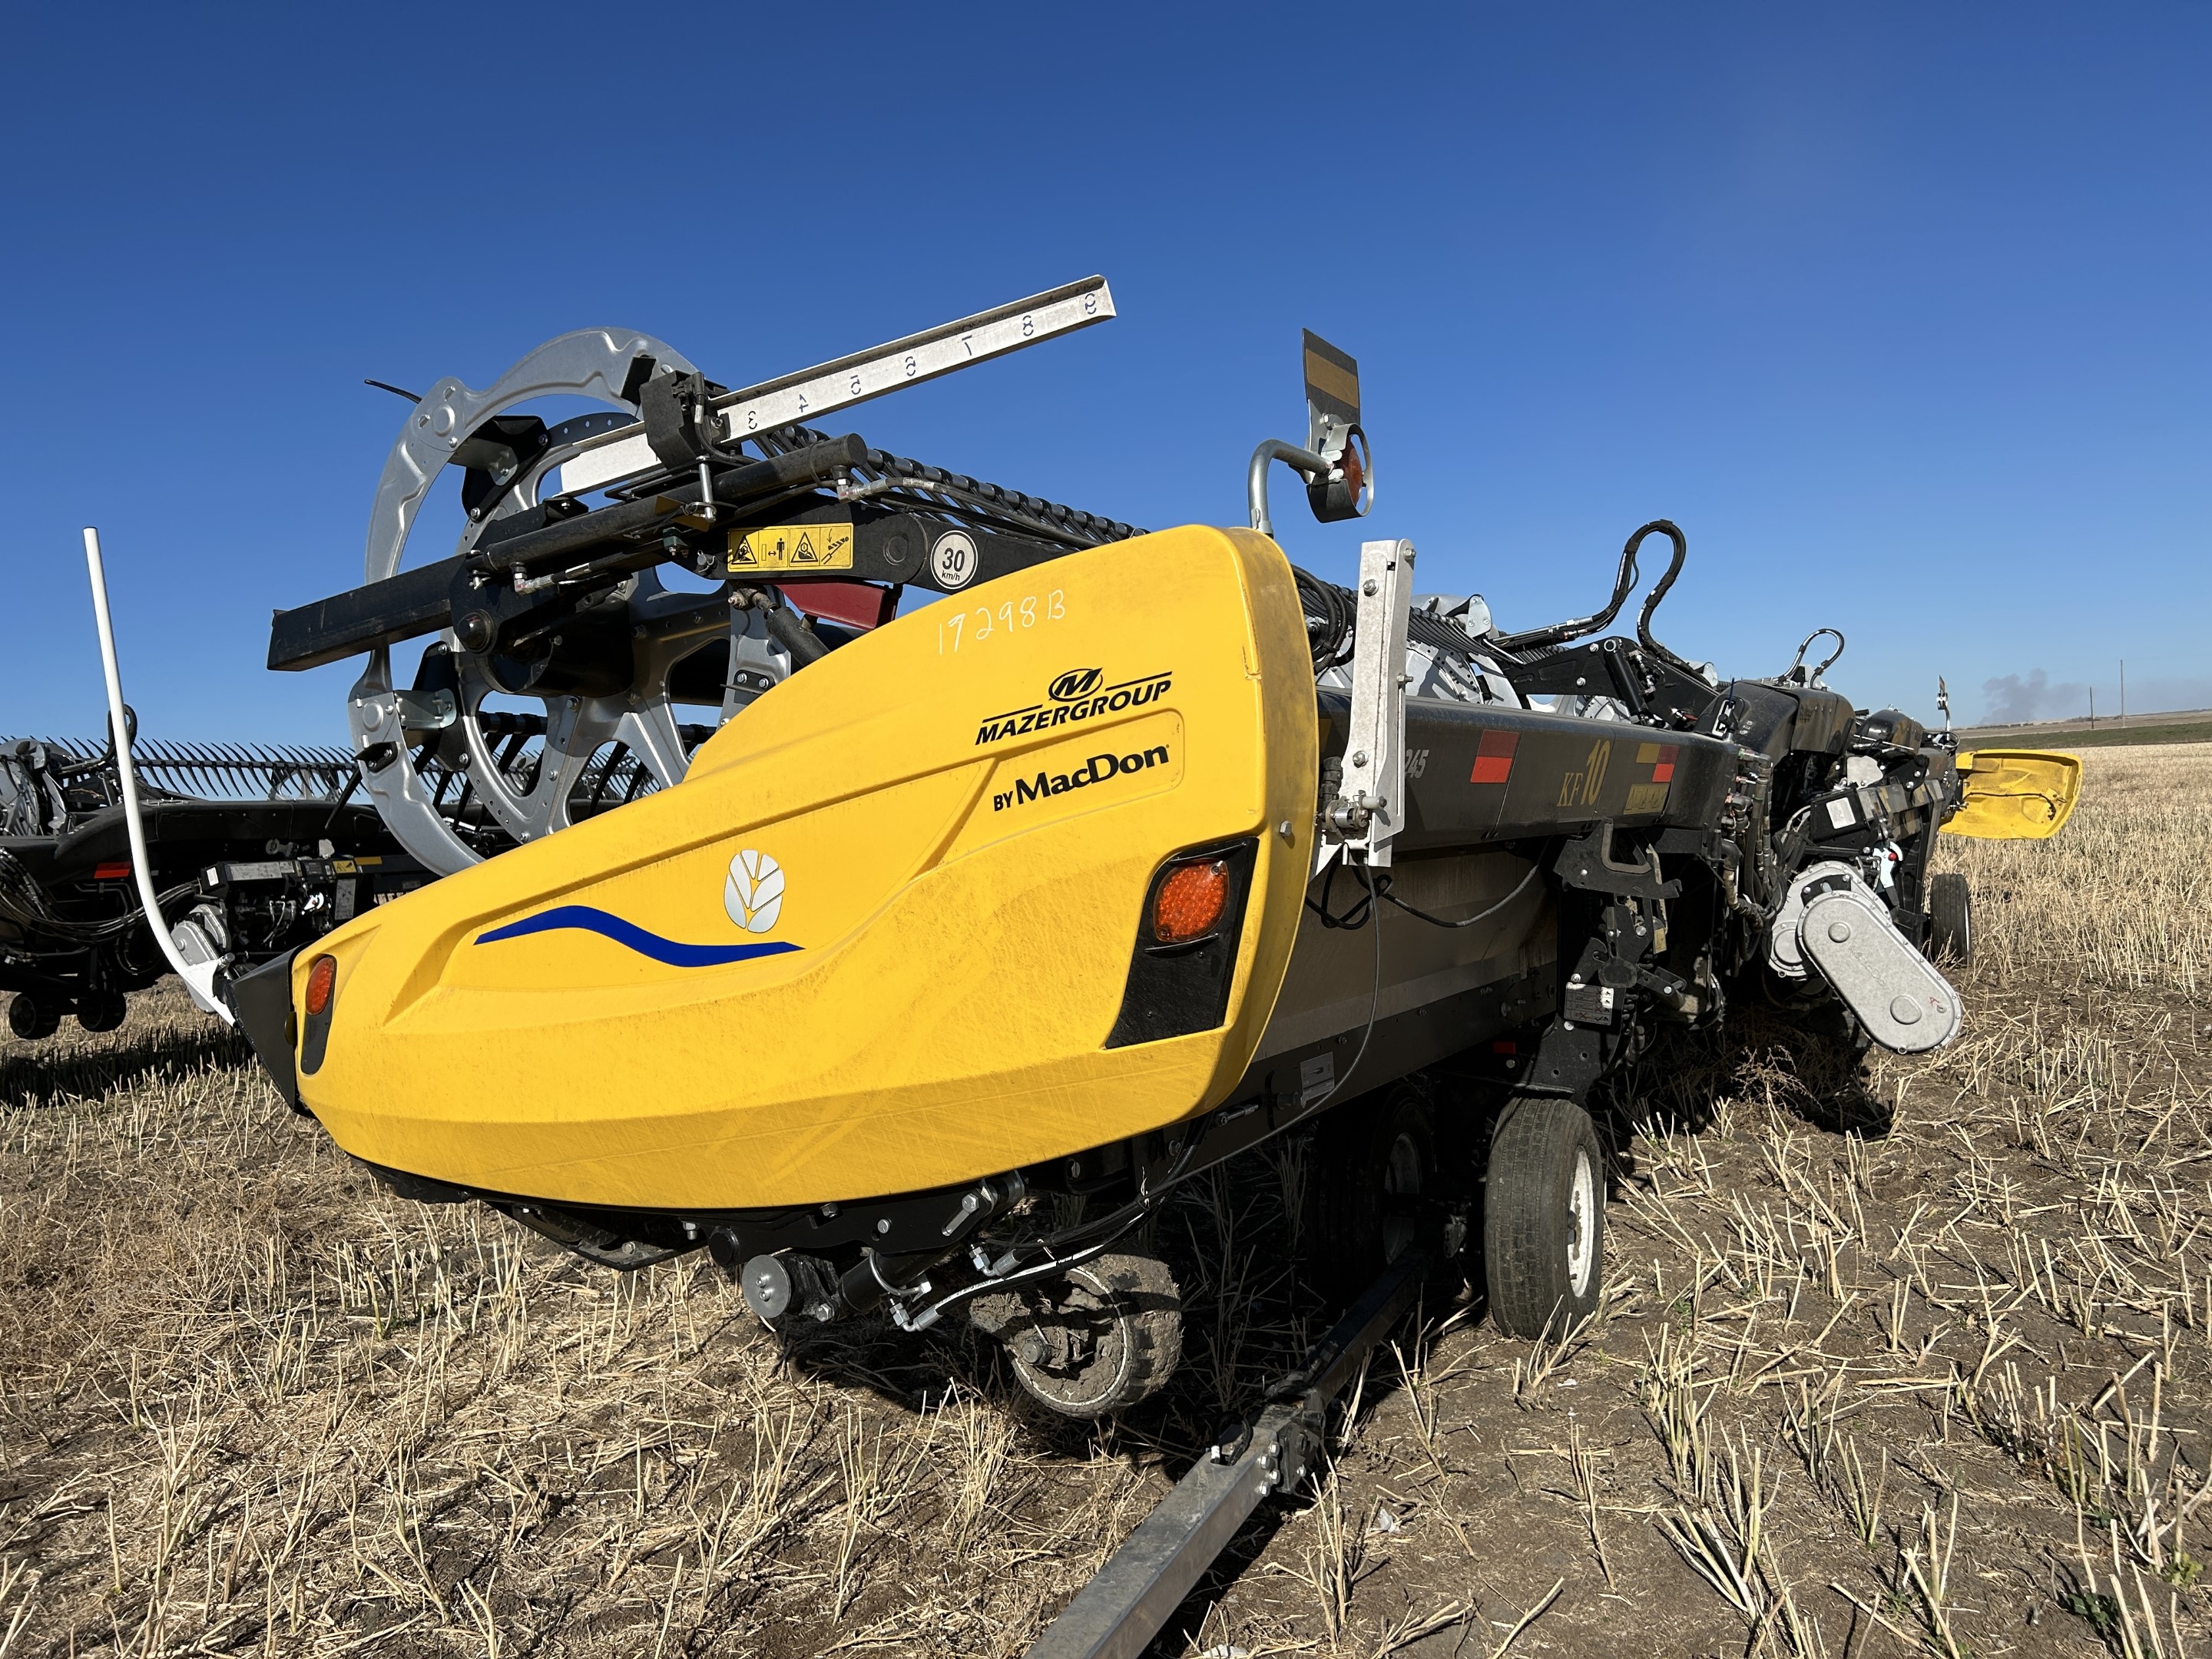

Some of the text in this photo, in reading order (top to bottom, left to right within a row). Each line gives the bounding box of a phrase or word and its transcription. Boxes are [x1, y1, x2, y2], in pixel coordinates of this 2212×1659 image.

[942, 547, 965, 572] 30
[942, 569, 960, 581] km/h
[975, 680, 1172, 746] MAZERGROUP
[993, 744, 1170, 813] BY MacDon
